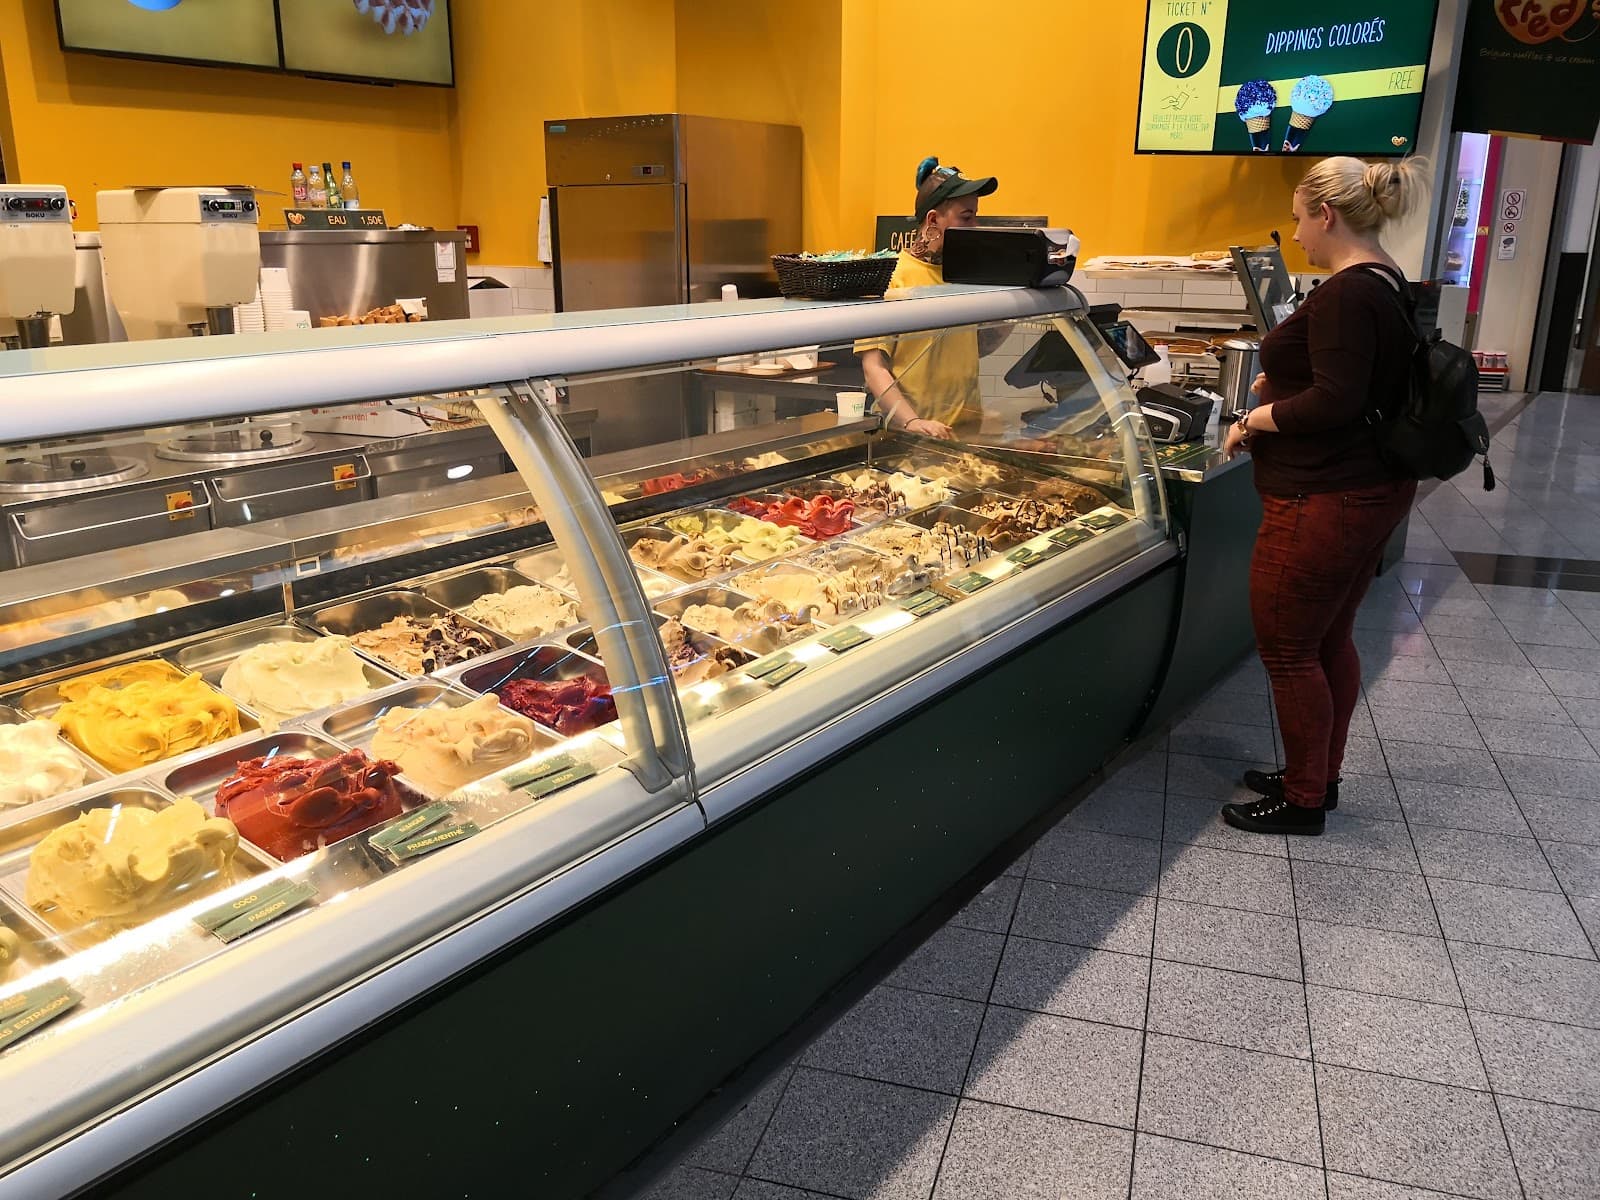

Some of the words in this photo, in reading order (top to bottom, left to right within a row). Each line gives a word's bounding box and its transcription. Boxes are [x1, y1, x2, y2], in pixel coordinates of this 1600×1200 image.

[1167, 1, 1198, 17] TICKET
[1265, 26, 1324, 55] DIPPINGS
[1328, 16, 1386, 48] COLORÉS
[1175, 26, 1194, 74] 0
[1388, 69, 1416, 91] FREE
[327, 215, 347, 225] EAU
[360, 215, 384, 226] 1,50€
[890, 229, 917, 251] CAFÉ
[406, 828, 465, 852] FRAISE-MENTHE
[232, 895, 258, 909] COCO
[248, 900, 287, 923] PASSION
[13, 995, 70, 1030] ESTRAGON
